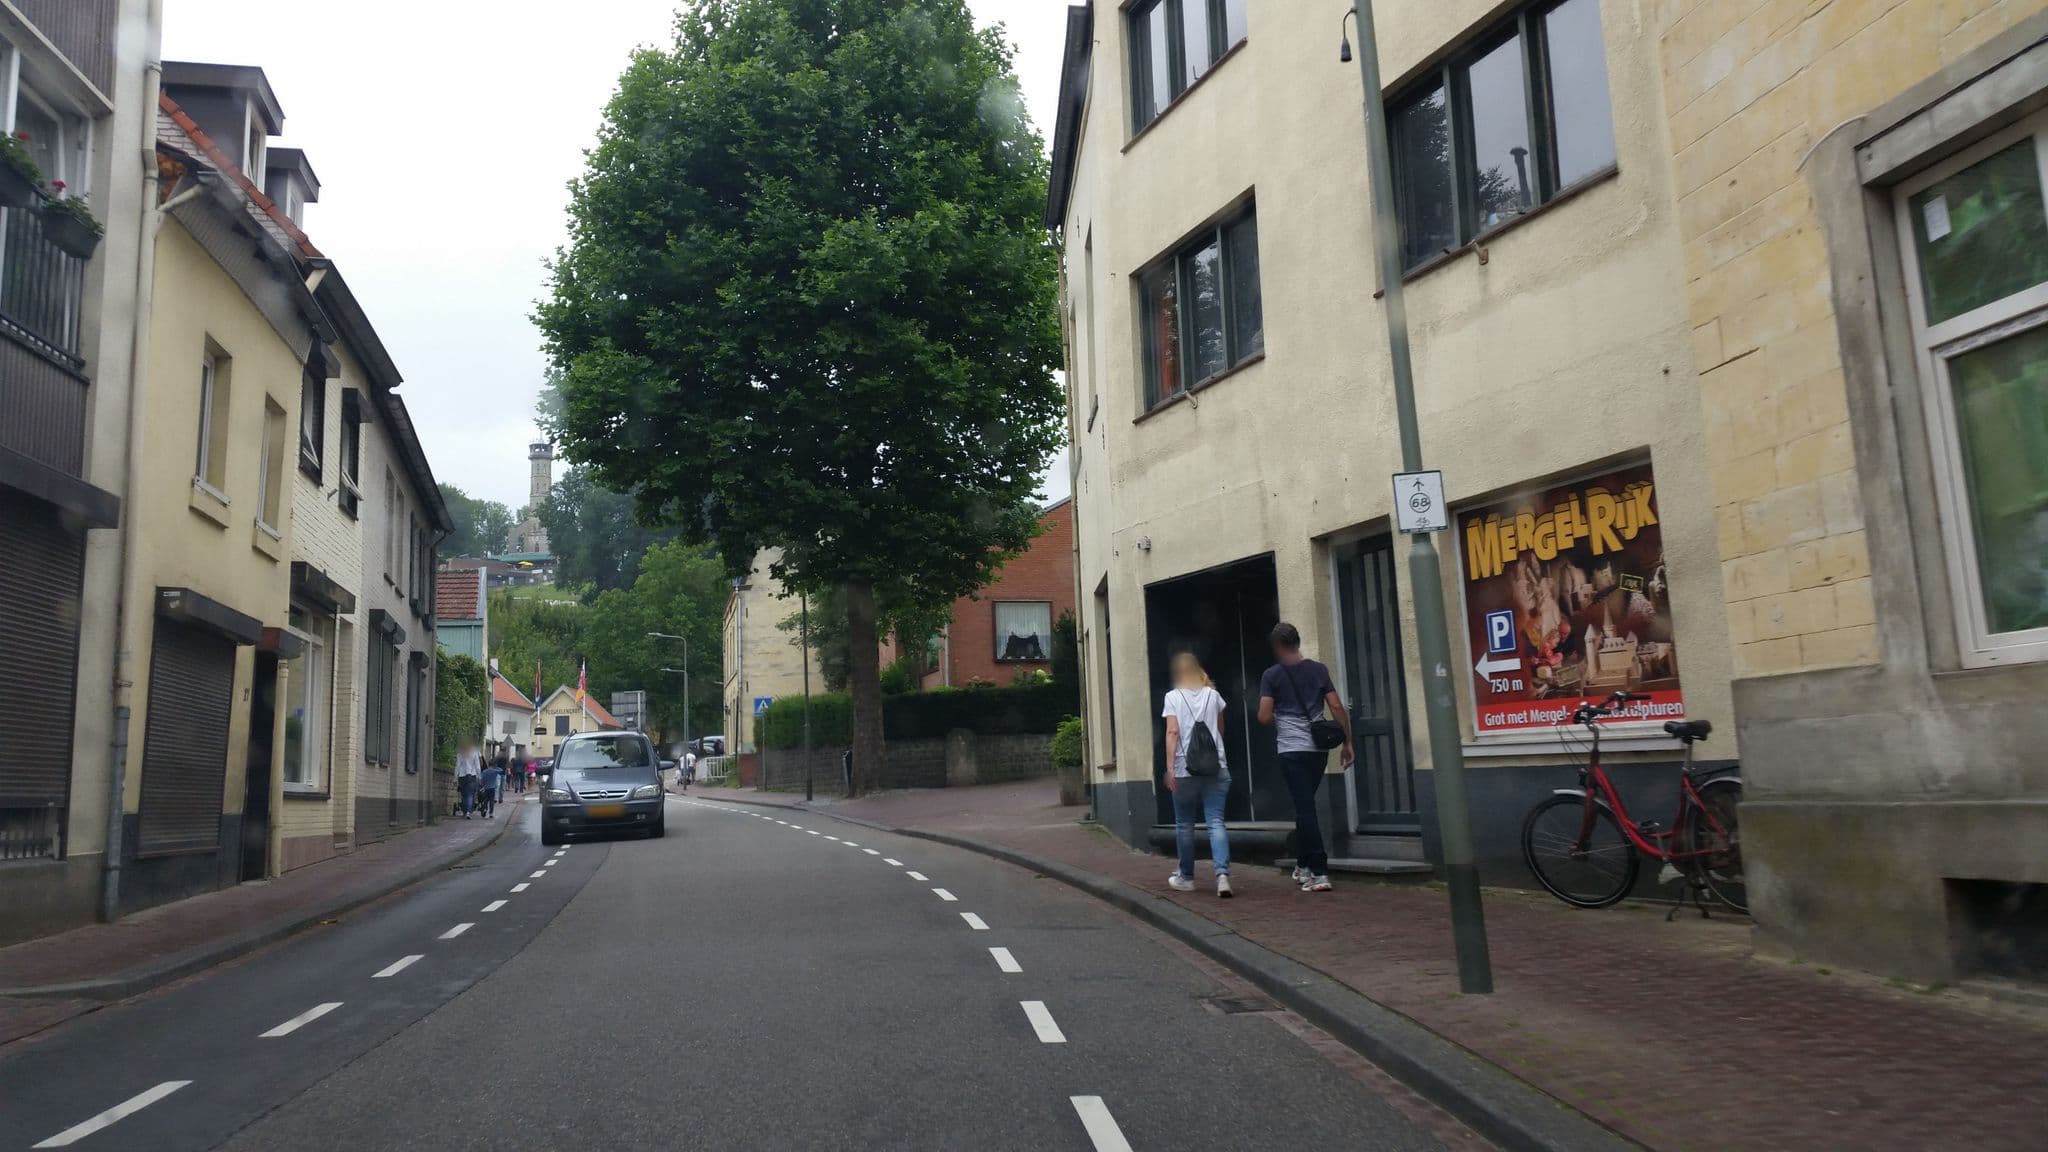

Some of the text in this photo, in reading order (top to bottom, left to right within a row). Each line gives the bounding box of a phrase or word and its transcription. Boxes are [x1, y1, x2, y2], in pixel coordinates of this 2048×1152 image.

[1412, 498, 1430, 508] 68
[1491, 616, 1509, 648] P
[1491, 678, 1523, 693] 750 m
[1486, 713, 1505, 726] Grot
[1507, 710, 1528, 724] met
